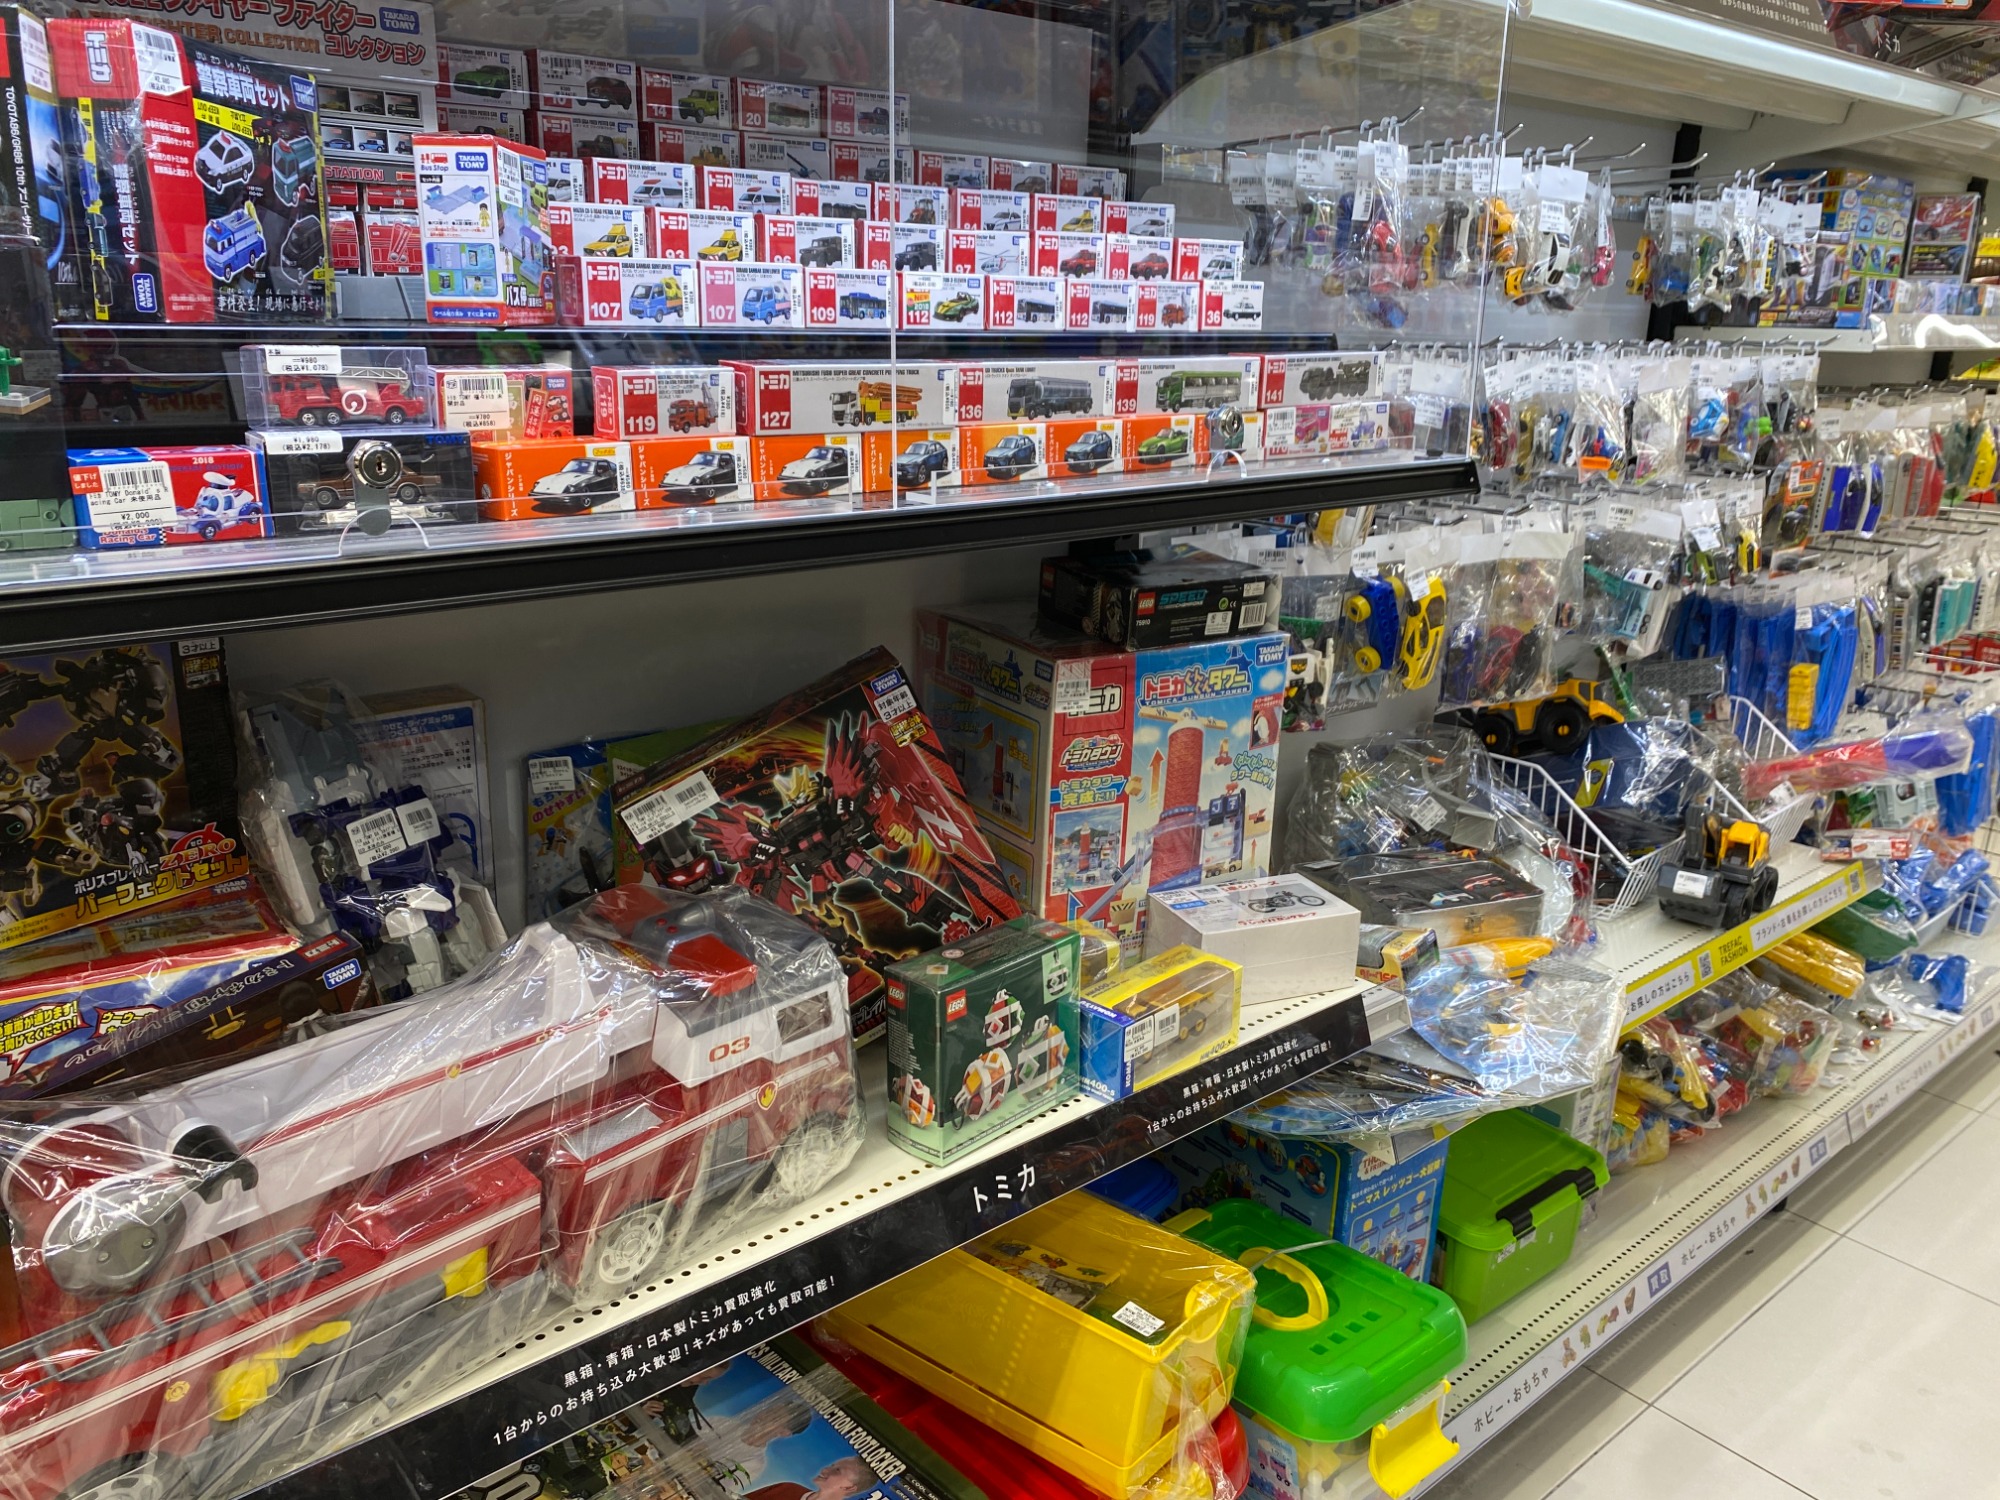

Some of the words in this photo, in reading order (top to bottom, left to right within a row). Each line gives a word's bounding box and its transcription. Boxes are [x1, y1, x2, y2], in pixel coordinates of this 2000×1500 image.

[272, 0, 376, 33] ファイター
[383, 10, 415, 22] TAKARA
[383, 19, 416, 31] TOMY
[224, 28, 320, 54] COLLECTION
[1876, 30, 1901, 53] トミカ
[325, 33, 426, 66] コレクション
[84, 31, 112, 84] トミカ
[195, 60, 290, 112] 警察車両セット
[651, 105, 667, 117] 14
[5, 85, 24, 160] TOYOTA86/GR86
[543, 117, 571, 133] トミカ
[746, 113, 762, 126] 20
[835, 121, 850, 134] 55
[457, 154, 485, 163] TAKARA
[835, 146, 858, 159] トミカ
[922, 156, 942, 168] トミカ
[994, 163, 1011, 174] トミカ
[15, 162, 25, 186] 10th
[599, 166, 627, 181] トミカ
[709, 173, 733, 188] トミカ
[796, 183, 818, 197] トミカ
[960, 195, 982, 208] トミカ
[1039, 200, 1057, 212] トミカ
[18, 186, 33, 235] アニバーサリー
[112, 164, 139, 265] 警察車両セット
[1108, 206, 1127, 218] トミカ
[661, 215, 688, 230] トミカ
[769, 222, 795, 237] トミカ
[952, 235, 975, 248] トミカ
[1039, 237, 1058, 250] トミカ
[1181, 245, 1199, 256] トミカ
[587, 264, 619, 281] トミカ
[706, 269, 734, 285] トミカ
[1112, 268, 1126, 279] 99
[810, 275, 835, 290] トミカ
[993, 281, 1014, 294] トミカ
[136, 278, 147, 307] TOMY
[144, 278, 153, 308] TAKARA
[1070, 285, 1090, 298] トミカ
[1139, 287, 1156, 299] トミカ
[591, 302, 620, 318] 107
[709, 305, 734, 320] 107
[812, 307, 835, 321] 109
[908, 311, 930, 323] 112
[1207, 310, 1221, 323] 36
[994, 312, 1013, 324] 112
[1070, 313, 1088, 325] 112
[1138, 315, 1155, 327] 119
[281, 364, 329, 372] (税込¥1,078)
[1267, 360, 1286, 373] トミカ
[760, 374, 790, 390] トミカ
[959, 371, 983, 385] トミカ
[1117, 368, 1138, 381] トミカ
[623, 379, 656, 395] トミカ
[1266, 389, 1282, 402] 141
[960, 405, 982, 419] 136
[1116, 398, 1137, 412] 139
[626, 417, 656, 433] 119
[762, 412, 790, 427] 127
[426, 435, 465, 446] TOMY
[192, 456, 214, 465] 2018
[759, 439, 769, 497] ジャパンシリーズ
[73, 473, 97, 482] 値下げ
[638, 445, 650, 506] ジャパンシリーズ
[74, 481, 99, 489] しました
[505, 452, 518, 517] ジャパンシリーズ
[131, 494, 161, 503] 未使用品
[121, 512, 150, 521] ¥2,000
[100, 536, 136, 544] Racing
[1139, 599, 1154, 608] LEGO
[182, 641, 216, 653] 3才以上
[1259, 644, 1284, 655] TAKARA
[1259, 652, 1283, 663] TOMY
[875, 674, 896, 687] TAKARA
[877, 677, 898, 692] TOMY
[1145, 668, 1248, 699] トミカぐんぐんタワー
[878, 690, 908, 710] 対象年齢
[1145, 697, 1177, 706] TOMICA
[1220, 687, 1248, 697] TOWER
[884, 701, 914, 720] 3才以上
[1060, 744, 1123, 767] トミカタウン
[1060, 776, 1123, 790] トミカタワー
[1062, 789, 1116, 808] 完成だ!!
[160, 837, 236, 869] ZERO
[73, 861, 158, 895] ポリスブレイバー
[215, 880, 247, 889] TAKARA
[76, 854, 243, 918] パーフェクトセット
[215, 885, 247, 894] TOMY
[304, 937, 341, 960] トミカ
[1718, 935, 1743, 955] TREFAC
[1721, 944, 1749, 966] FASHION
[327, 961, 355, 978] TAKARA
[328, 968, 358, 985] TOMY
[889, 986, 905, 1001] LEGO
[947, 997, 966, 1012] LEGO
[708, 1036, 751, 1063] 03
[1182, 1038, 1300, 1099] 黒箱・青箱・日本製トミカ買取強化
[1147, 1040, 1332, 1134] 1台からのお持ち込み大歓迎!キズがあっても買取可能!
[972, 1161, 1038, 1214] トミカ
[1350, 1190, 1380, 1213] トーマス
[1680, 1215, 1736, 1266] ホビー・おもちゃ
[1649, 1268, 1671, 1293] 買取
[562, 1278, 777, 1388] 黒箱・青箱・日本製トミカ買取強化
[493, 1274, 836, 1447] 1台からのお持ち込み大歓迎!キズがあっても買取可能!
[1473, 1366, 1550, 1433] ホビー・おもちゃ
[759, 1350, 802, 1384] MILITARY
[844, 1427, 907, 1484] FOOTLOCKER
